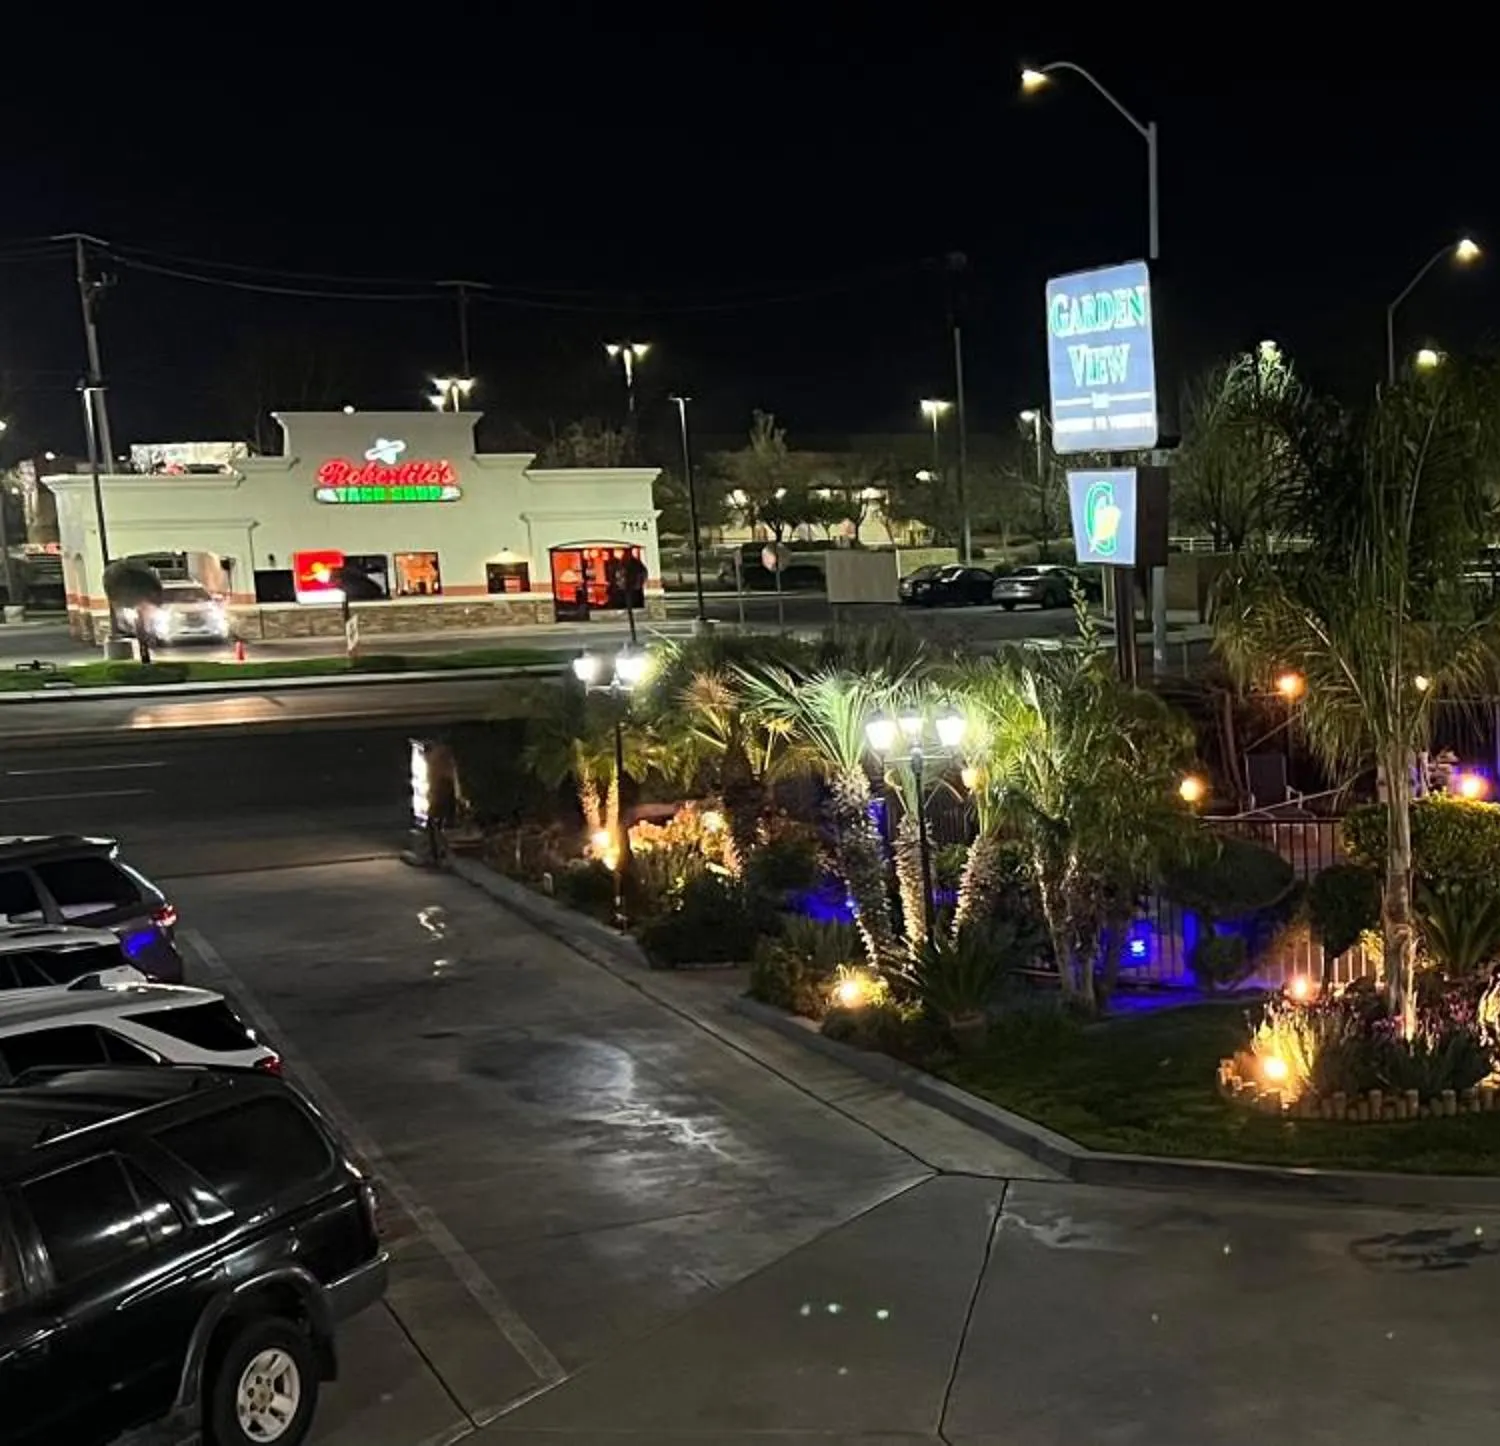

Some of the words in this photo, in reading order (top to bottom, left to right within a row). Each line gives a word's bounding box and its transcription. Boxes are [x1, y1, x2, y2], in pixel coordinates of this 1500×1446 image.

[1051, 286, 1148, 338] GARDEN
[1068, 344, 1130, 386] VIEW
[620, 521, 649, 534] 7114
